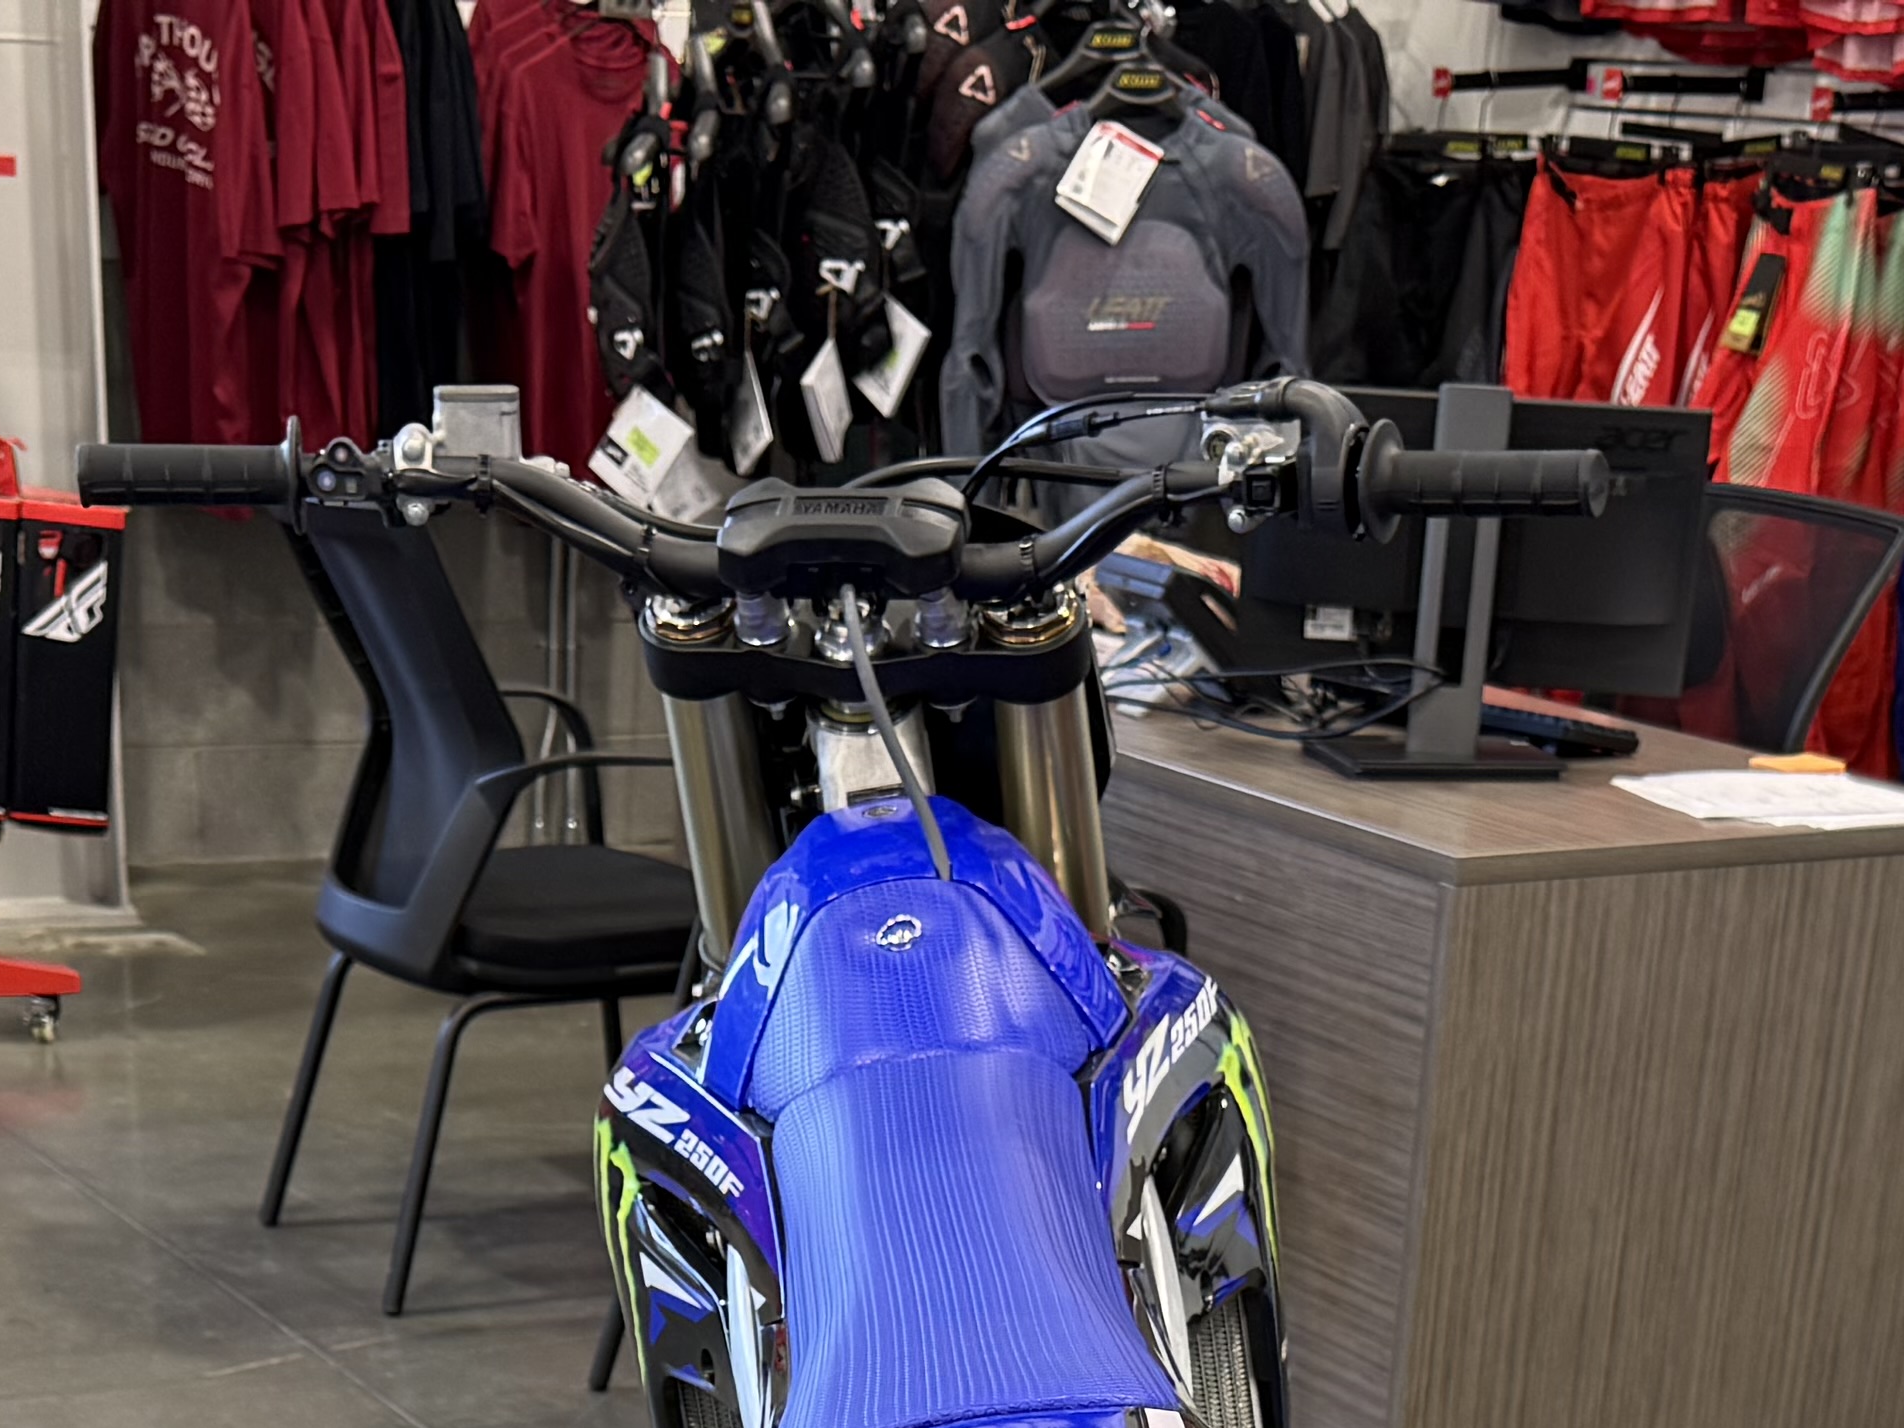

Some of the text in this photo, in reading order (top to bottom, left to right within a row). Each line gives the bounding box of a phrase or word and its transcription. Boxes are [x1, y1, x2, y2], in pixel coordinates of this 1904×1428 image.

[801, 502, 877, 516] YAMAHA
[1123, 975, 1219, 1145] YZ 250F
[604, 1066, 745, 1198] YZ 250F
